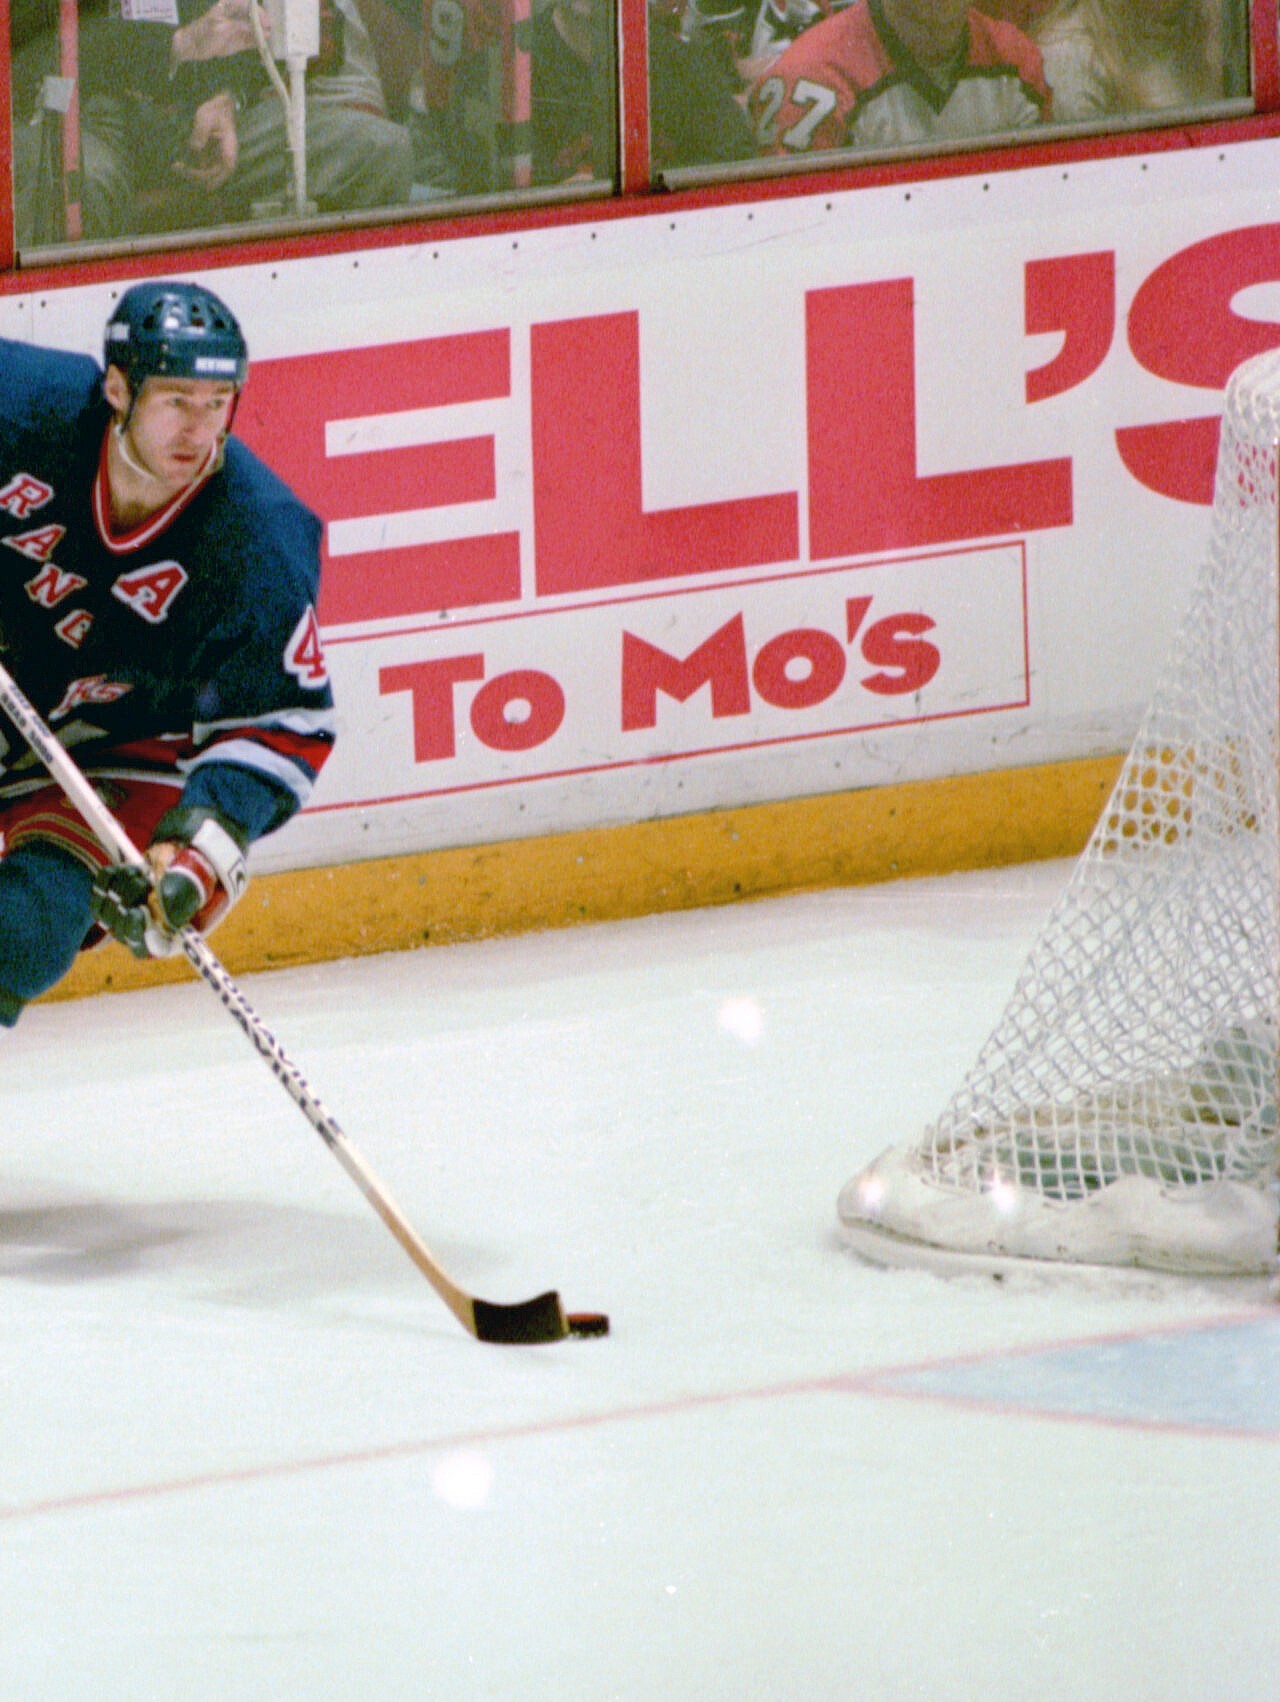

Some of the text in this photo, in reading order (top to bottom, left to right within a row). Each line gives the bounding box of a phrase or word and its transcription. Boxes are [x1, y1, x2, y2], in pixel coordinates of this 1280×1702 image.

[756, 76, 837, 150] 27
[110, 559, 189, 624] A
[283, 604, 329, 689] 4
